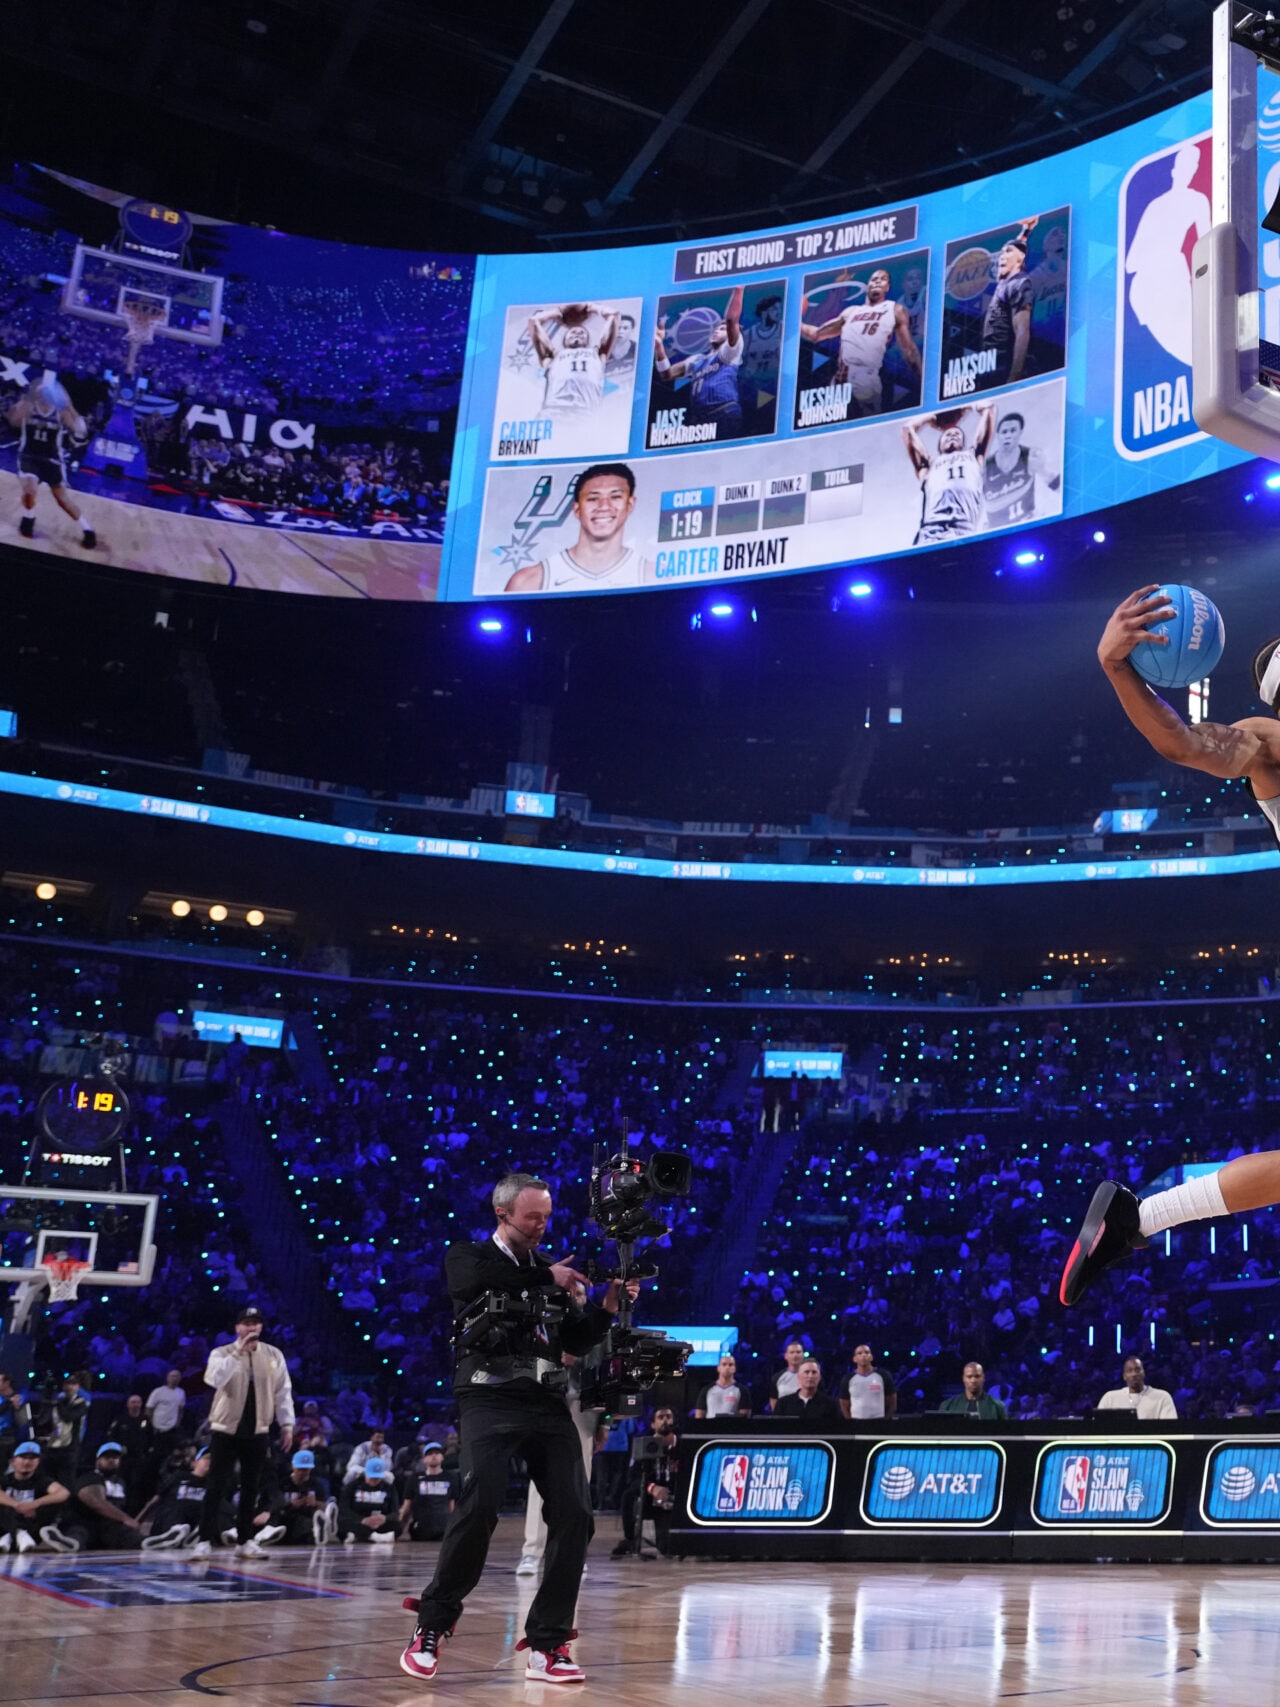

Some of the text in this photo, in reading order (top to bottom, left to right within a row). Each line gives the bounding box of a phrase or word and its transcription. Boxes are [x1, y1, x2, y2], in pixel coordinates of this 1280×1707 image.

[138, 245, 180, 260] TISSOT
[695, 249, 736, 274] FIRST
[736, 240, 784, 268] ROUND
[796, 232, 823, 258] TOP
[824, 230, 833, 253] 2
[834, 216, 897, 250] ADVANCE
[947, 348, 997, 378] JAXSON
[943, 373, 976, 398] HAYES
[799, 383, 852, 412] KESHAD
[1133, 374, 1192, 440] NBA
[652, 408, 687, 430] JASE
[798, 404, 849, 428] JOHNSON
[500, 420, 553, 440] CARTER
[650, 423, 717, 447] RICHARDSON
[498, 438, 540, 457] BRYANT
[823, 468, 850, 488] TOTAL
[948, 466, 966, 480] 11
[725, 485, 748, 502] DUNK
[770, 477, 802, 495] DUNK 2
[673, 490, 702, 508] CLOCK
[670, 510, 703, 538] 1:19
[655, 537, 789, 579] CARTER BRYANT
[1188, 590, 1210, 650] Wilson
[60, 1154, 112, 1167] TISSOT
[766, 1456, 790, 1464] AT&T
[1107, 1456, 1130, 1465] AT&T
[750, 1467, 789, 1488] SLAM
[919, 1473, 982, 1494] AT&T
[1091, 1467, 1129, 1489] SLAM
[746, 1489, 786, 1511] DUNK
[1088, 1490, 1126, 1512] DUNK
